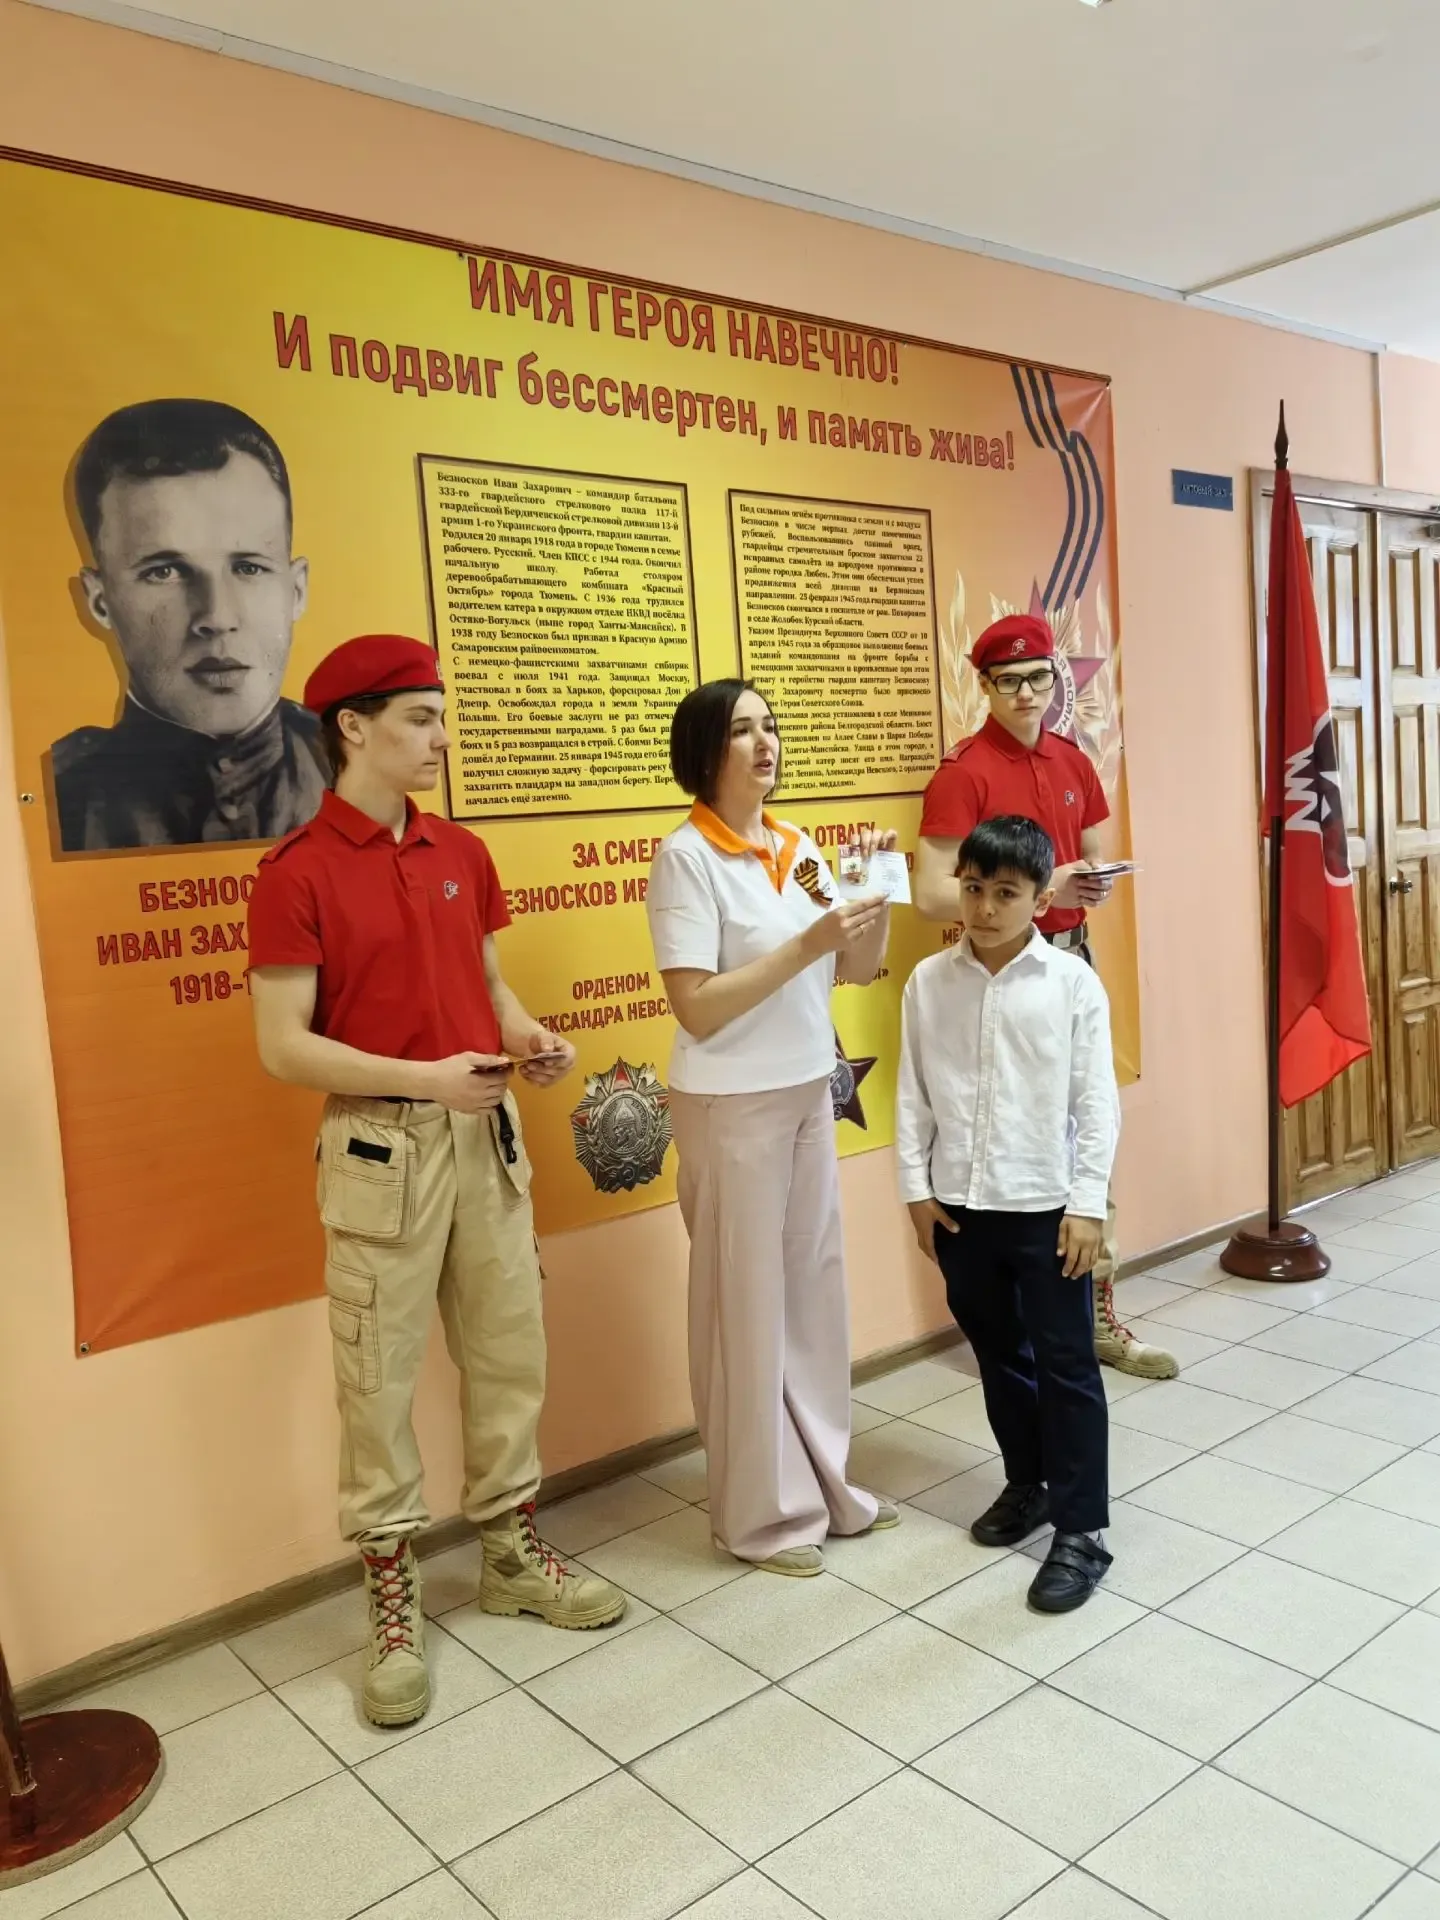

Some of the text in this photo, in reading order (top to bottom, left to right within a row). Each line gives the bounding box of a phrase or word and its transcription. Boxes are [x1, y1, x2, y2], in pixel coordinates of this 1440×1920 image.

[468, 256, 899, 385] ИМЯ ГЕРОЯ НАВЕЧНО!
[273, 311, 1014, 471] И подвиг бессмертен, и память жива!
[437, 471, 676, 505] Безносков Иван Захарович командир батальона
[438, 486, 469, 498] 333-го
[555, 499, 611, 514] стрелкового
[620, 505, 646, 515] полка
[439, 499, 502, 517] гвардейской
[570, 511, 622, 528] стрелковой
[440, 516, 474, 528] армии
[496, 519, 557, 535] Украинского
[441, 528, 649, 553] Родился января 1918 городе Тюмени
[538, 550, 562, 560] Член
[564, 552, 590, 562] КПСС
[600, 554, 618, 564] 1944
[444, 559, 682, 583] начальную Работал столяром
[446, 584, 494, 599] Октябрь»
[500, 590, 533, 601] города
[596, 593, 616, 603] 1936
[641, 582, 683, 596] «Красный
[448, 601, 650, 619] водителем катера окружном отделе НКВД
[568, 620, 594, 630] город
[451, 628, 687, 647] 1938 Безносков призван Красную Армию
[451, 642, 518, 655] Самаровским
[549, 672, 568, 680] 1941
[609, 673, 650, 683] Защищал
[455, 686, 511, 696] участвовал
[608, 685, 661, 697] форсировал
[497, 698, 556, 708] Освобождал
[562, 700, 593, 709] города
[568, 714, 602, 723] заслуги
[518, 740, 579, 750] возвращался
[461, 753, 493, 764] дошёл
[570, 753, 602, 763] января
[603, 751, 623, 760] 1945
[462, 763, 667, 779] получил сложную задачу форсировать реку
[463, 782, 513, 791] захватить
[515, 781, 562, 791] плацдарм
[577, 779, 620, 788] западном
[465, 796, 509, 805] началась
[573, 842, 600, 868] ЗА
[139, 874, 257, 912] БЕЗНОС
[502, 881, 617, 915] ЕЗНОСКОВ
[97, 928, 182, 966] ИВАН
[170, 968, 252, 1005] 1918-1
[572, 972, 650, 1000] ОРДЕНОМ
[535, 997, 671, 1034] ЕКСАНДРА НЕВС
